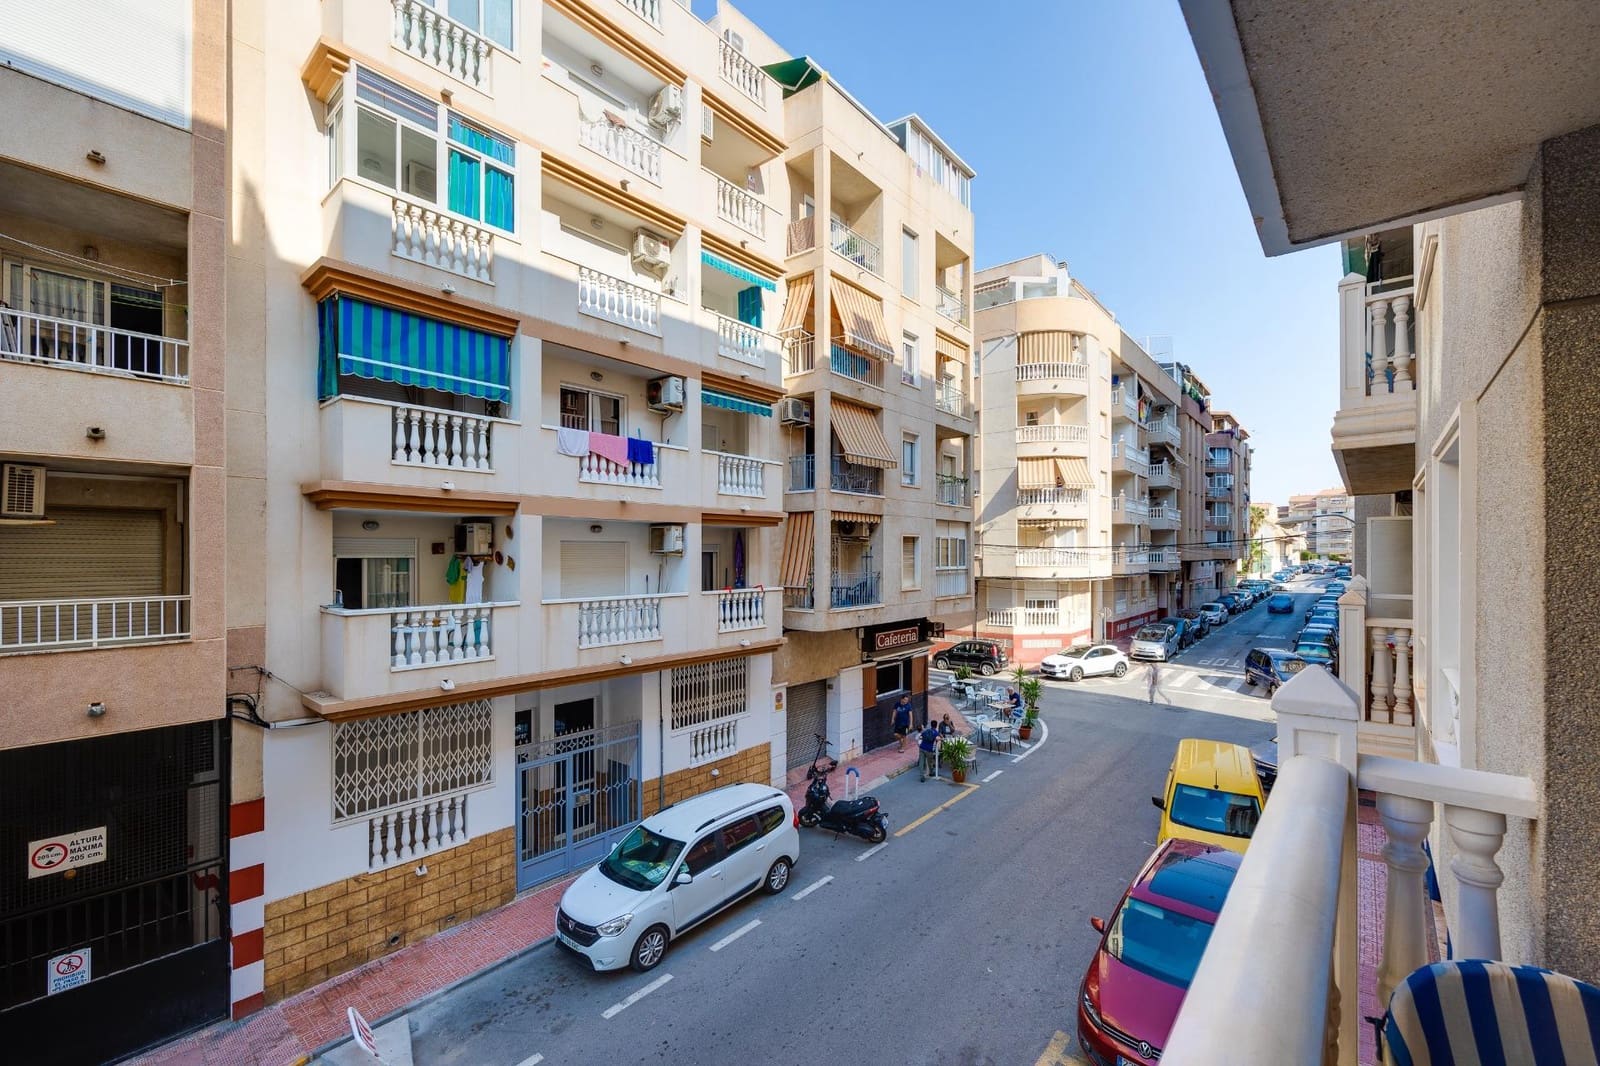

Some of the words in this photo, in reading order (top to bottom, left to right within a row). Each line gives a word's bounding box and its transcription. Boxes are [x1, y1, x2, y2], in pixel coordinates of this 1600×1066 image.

[877, 630, 917, 647] Cafeteria
[1198, 659, 1246, 669] TOP
[69, 834, 103, 847] ALTURA
[37, 853, 49, 861] 205
[69, 853, 85, 863] 205
[87, 851, 103, 859] cm.
